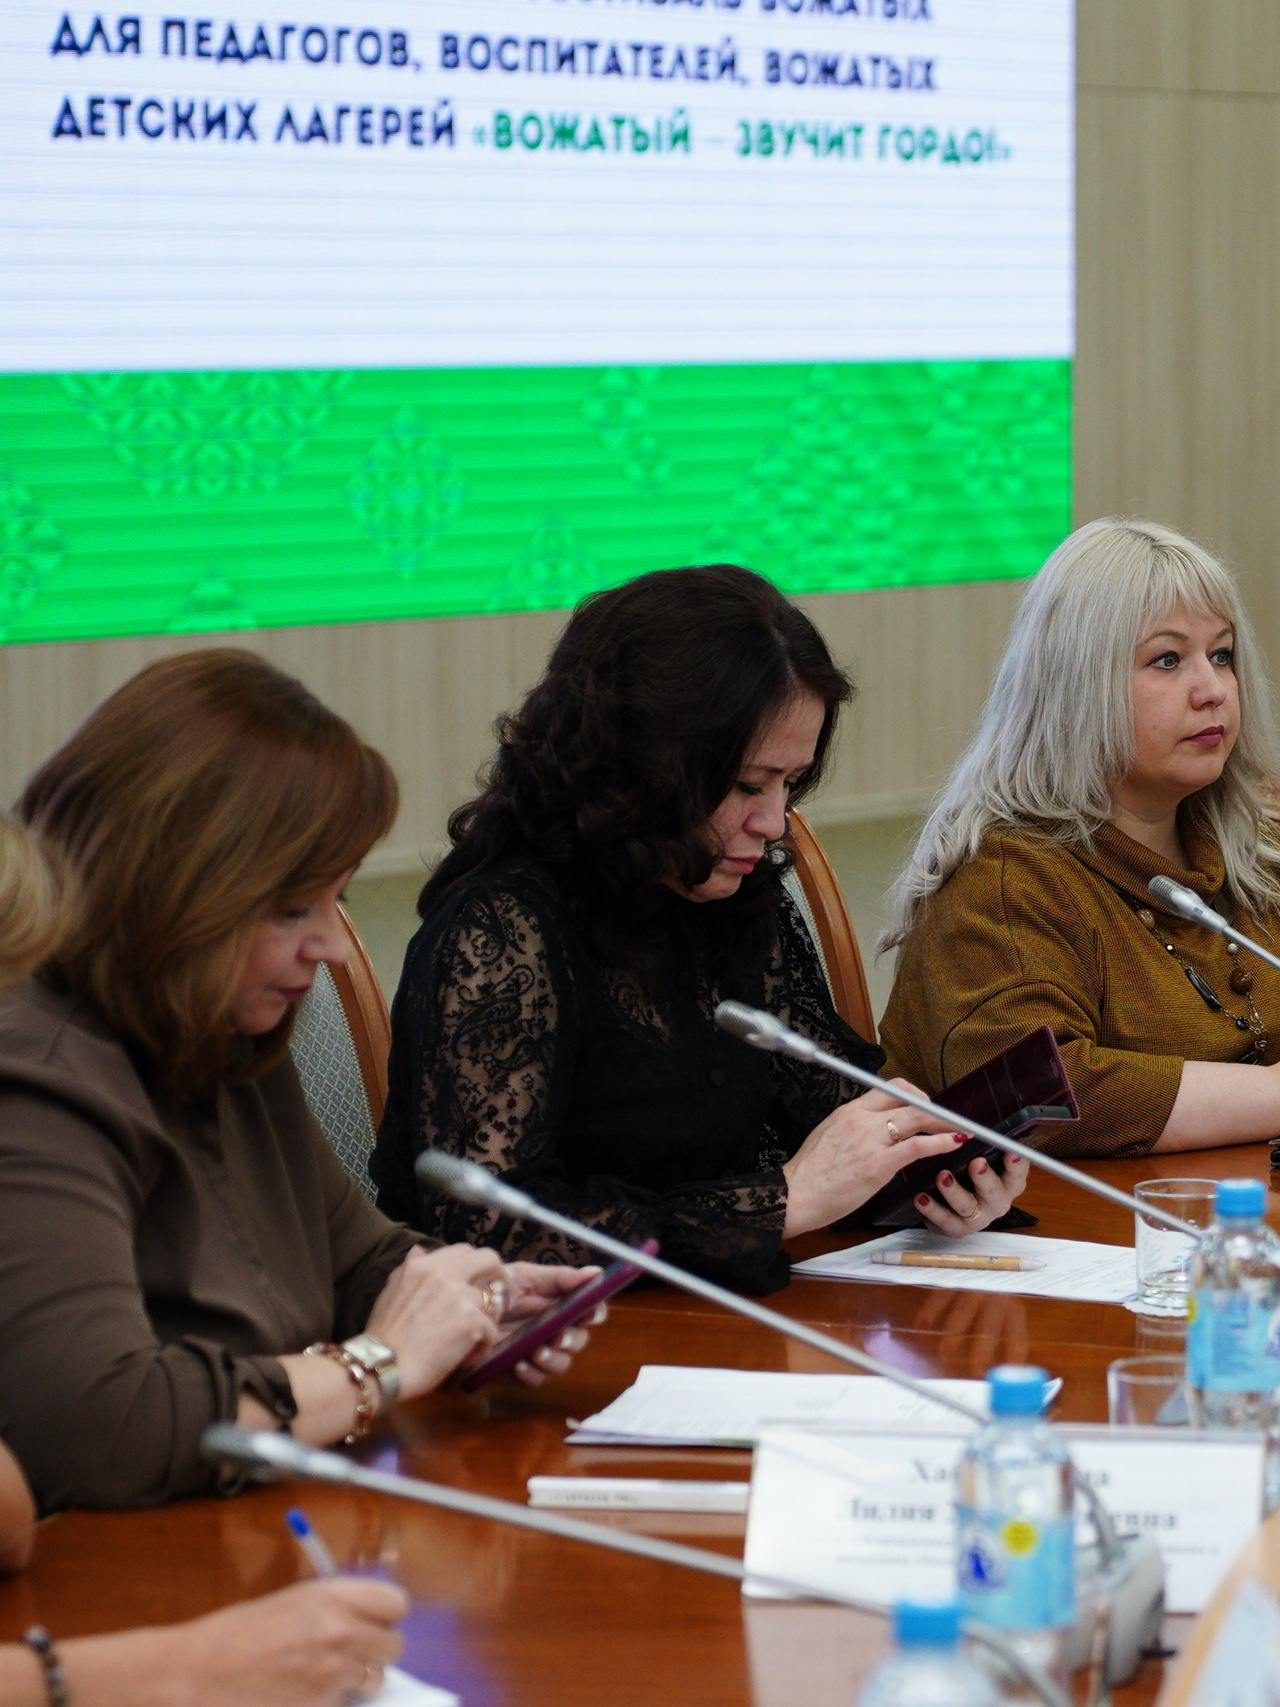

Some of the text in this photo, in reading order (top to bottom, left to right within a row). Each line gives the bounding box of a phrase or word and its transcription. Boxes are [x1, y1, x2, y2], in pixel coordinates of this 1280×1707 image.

[50, 13, 937, 92] ДЛЯ ПЕДАГОГОВ, ВОСПИТАТЕЛЕЙ, ВОЖАТЫХ
[51, 96, 259, 143] ДЕТСКИХ
[275, 98, 456, 148] ЛАГЕРЕЙ
[474, 107, 692, 155] «ВОЖАТЫЙ
[736, 117, 864, 160] ЗВУЧИТ
